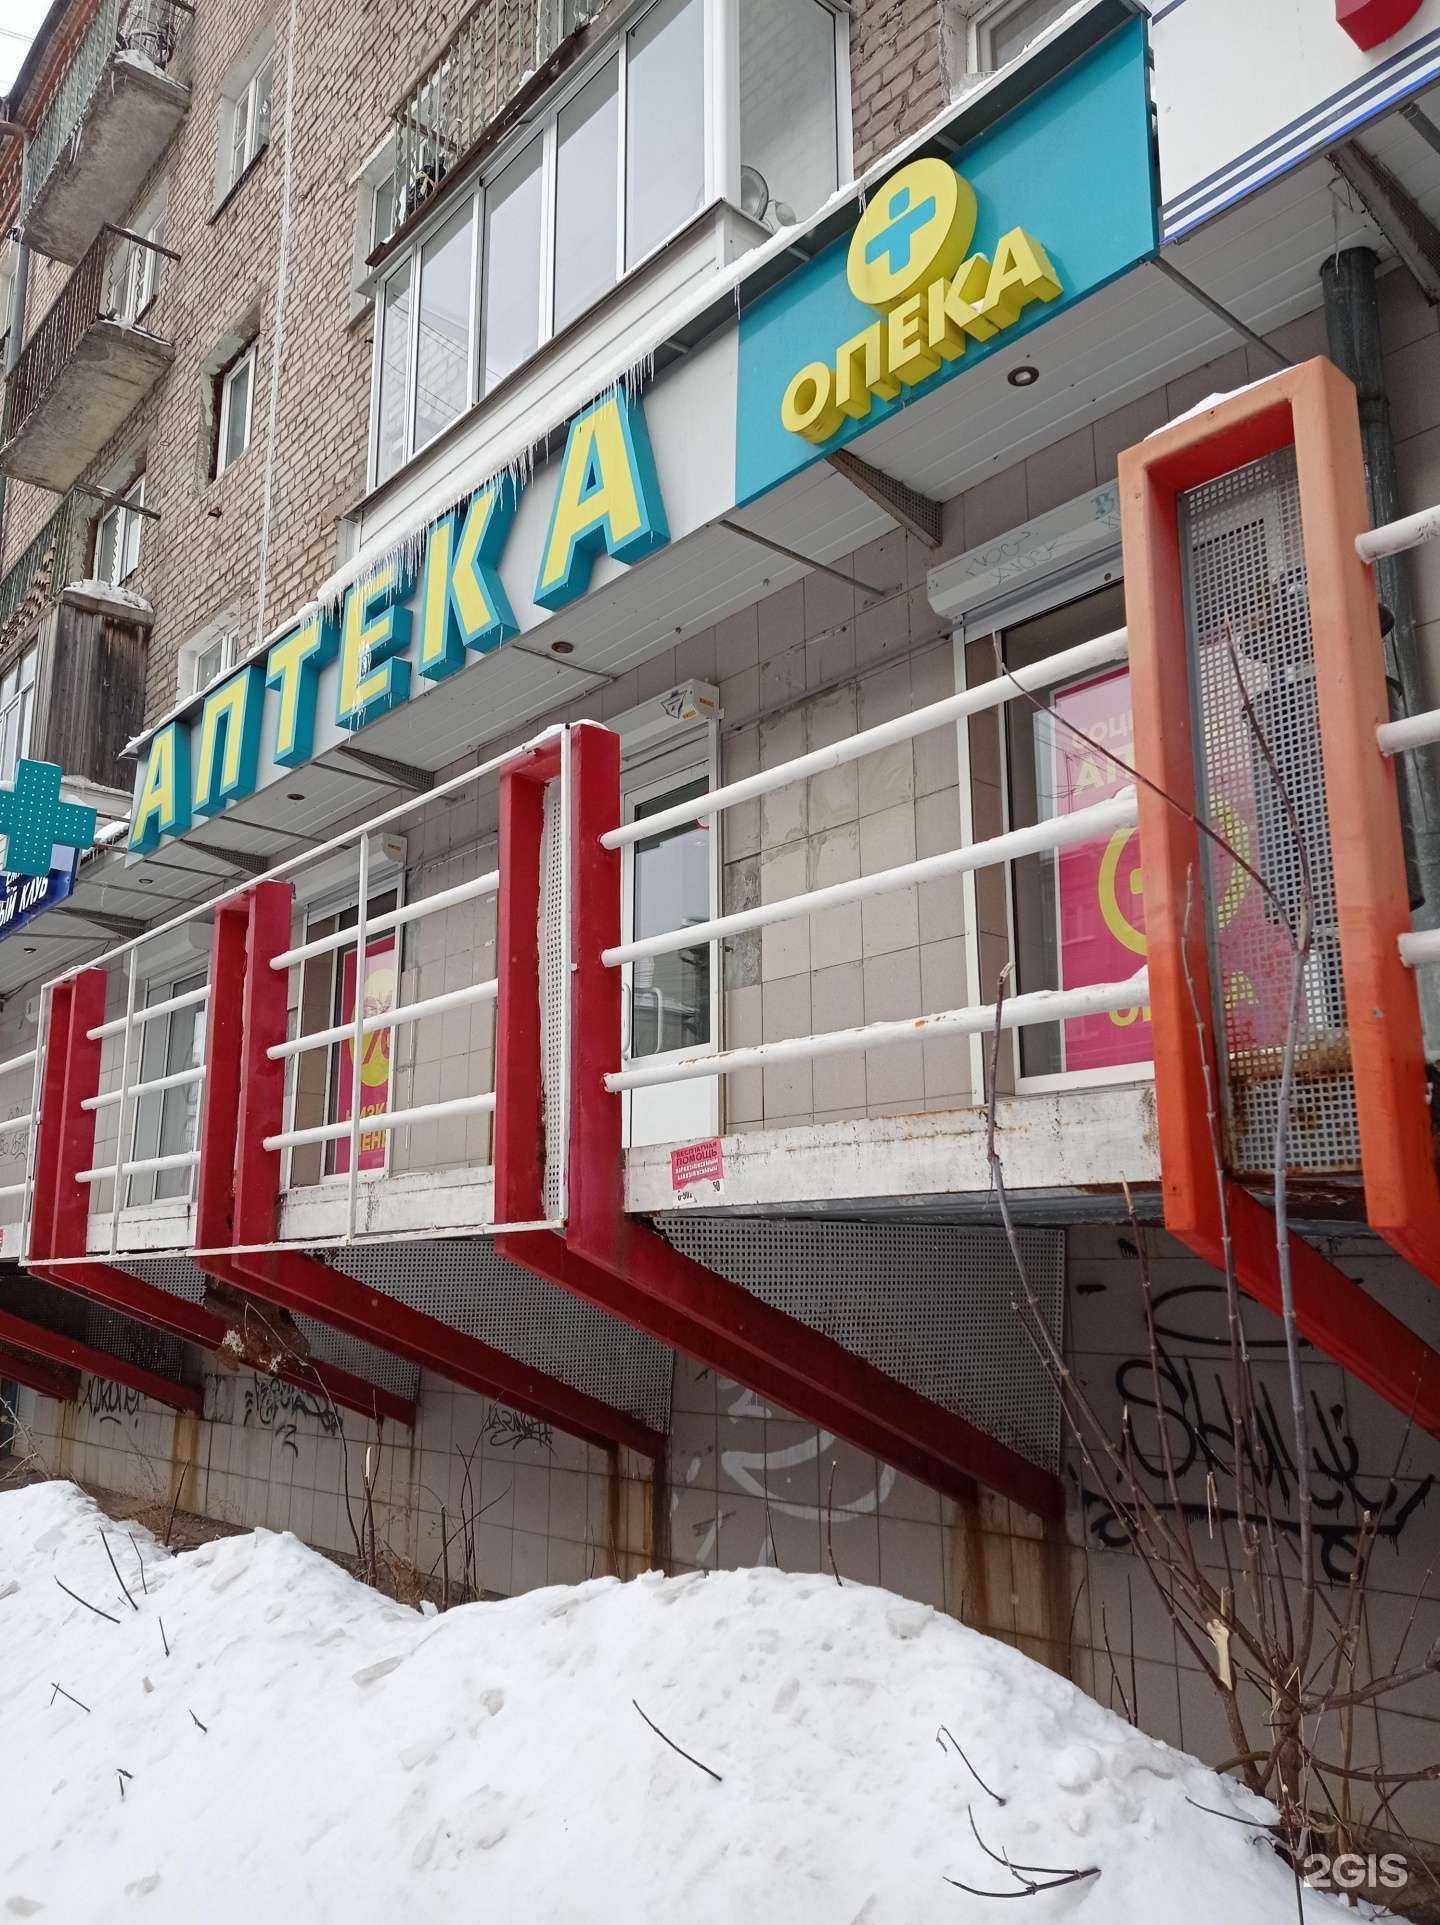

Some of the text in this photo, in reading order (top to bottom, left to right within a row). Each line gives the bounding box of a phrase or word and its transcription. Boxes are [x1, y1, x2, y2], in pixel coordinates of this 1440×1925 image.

[781, 226, 1064, 444] ОПЕКА
[128, 385, 670, 855] АПТЕКА
[676, 1149, 719, 1167] ПОМОЩЬ
